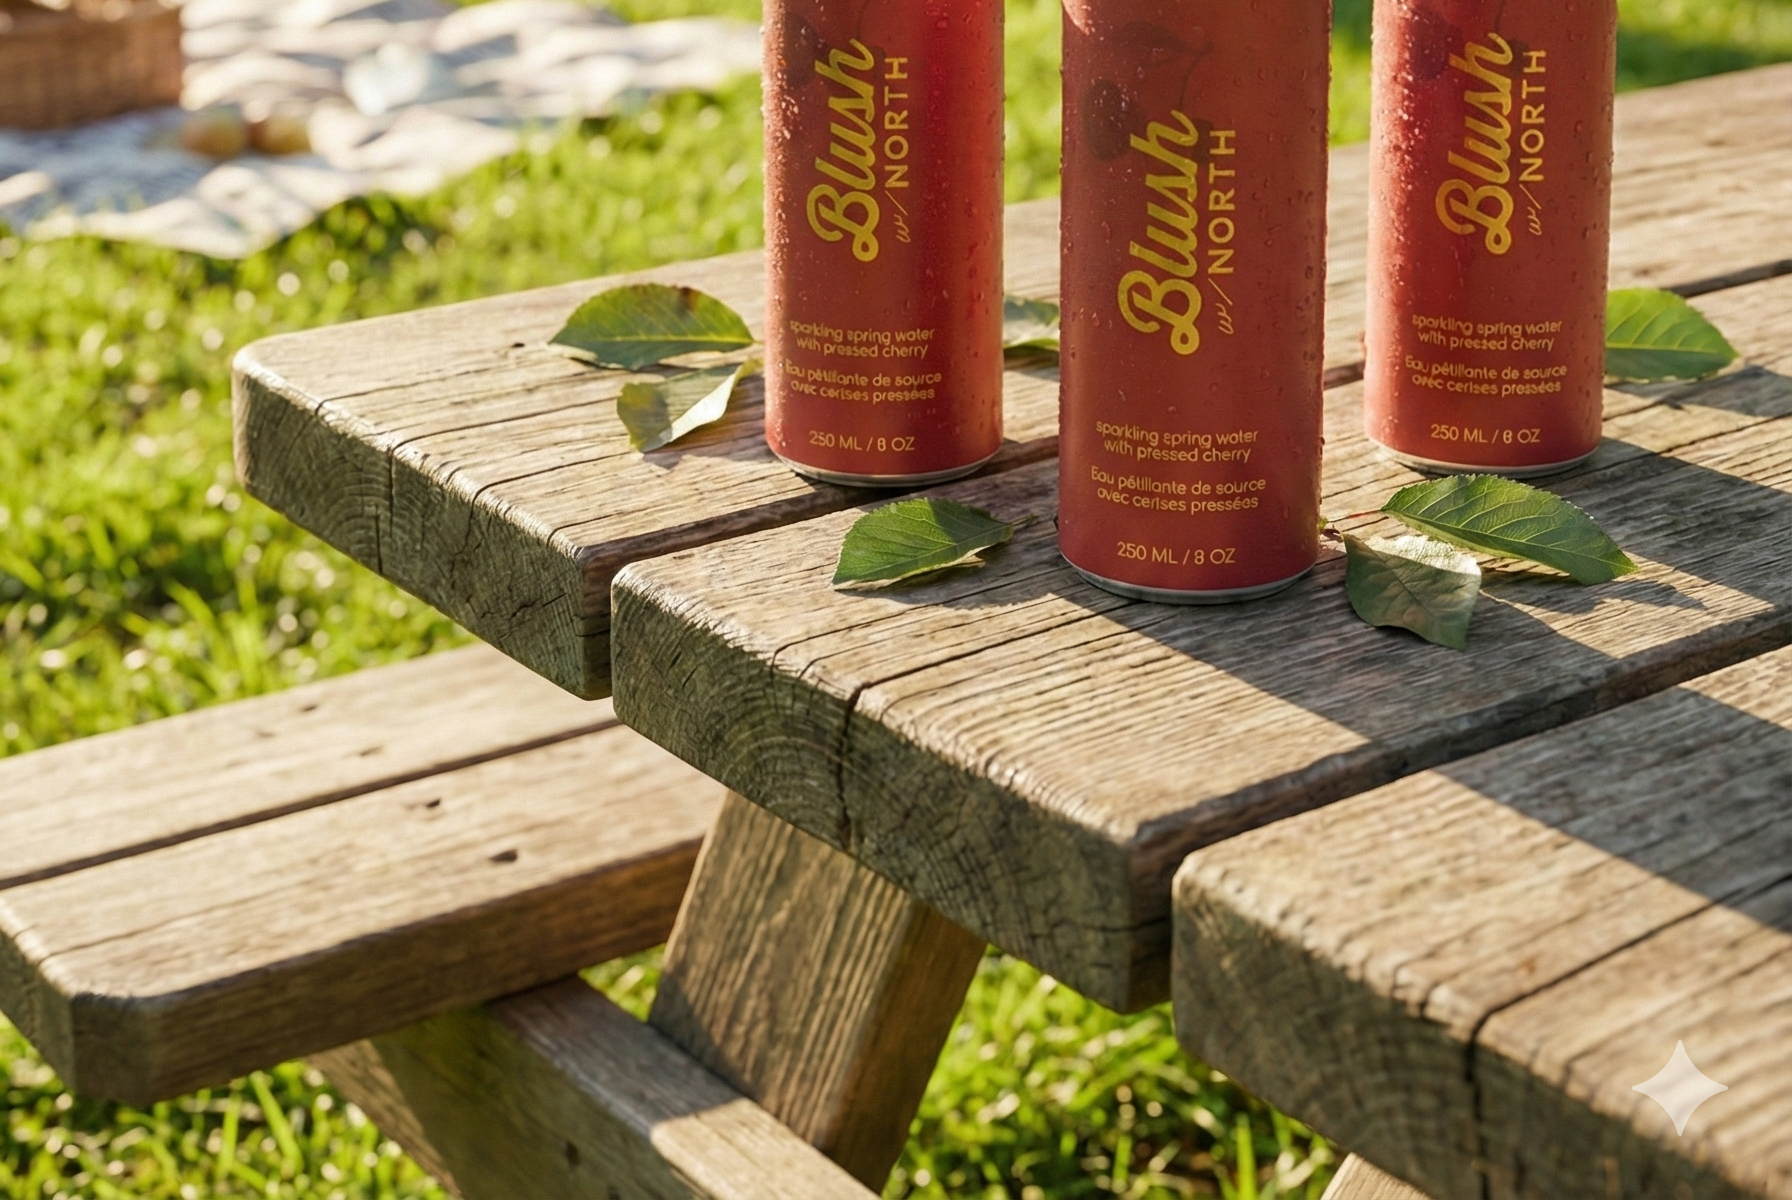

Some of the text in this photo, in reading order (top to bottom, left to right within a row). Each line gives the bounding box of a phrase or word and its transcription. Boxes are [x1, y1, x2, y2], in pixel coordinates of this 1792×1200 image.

[884, 57, 909, 188] NORTH
[1518, 50, 1546, 181] NORTH
[806, 38, 880, 262] Blush
[1435, 32, 1513, 254] Blush
[1207, 130, 1235, 274] NORTH
[1117, 109, 1202, 355] Blush
[847, 328, 891, 345] spring
[895, 328, 935, 342] water
[1511, 338, 1554, 352] cherry
[824, 345, 878, 357] pressed
[883, 345, 928, 359] cherry
[873, 373, 891, 386] de
[1502, 367, 1519, 379] de
[809, 430, 835, 447] 250
[839, 435, 862, 450] ML
[877, 437, 886, 451] 8
[891, 437, 915, 451] OZ
[1096, 421, 1259, 449] sparkling spring water
[1431, 424, 1459, 441] 250
[1464, 428, 1487, 443] ML
[1518, 429, 1540, 443] OZ
[1104, 440, 1251, 463] with pressed cherry
[1091, 465, 1266, 495] Eau pétillante de source
[1097, 487, 1259, 515] avec cerises pressées
[1117, 541, 1236, 565] 250 ML / 8 OZ
